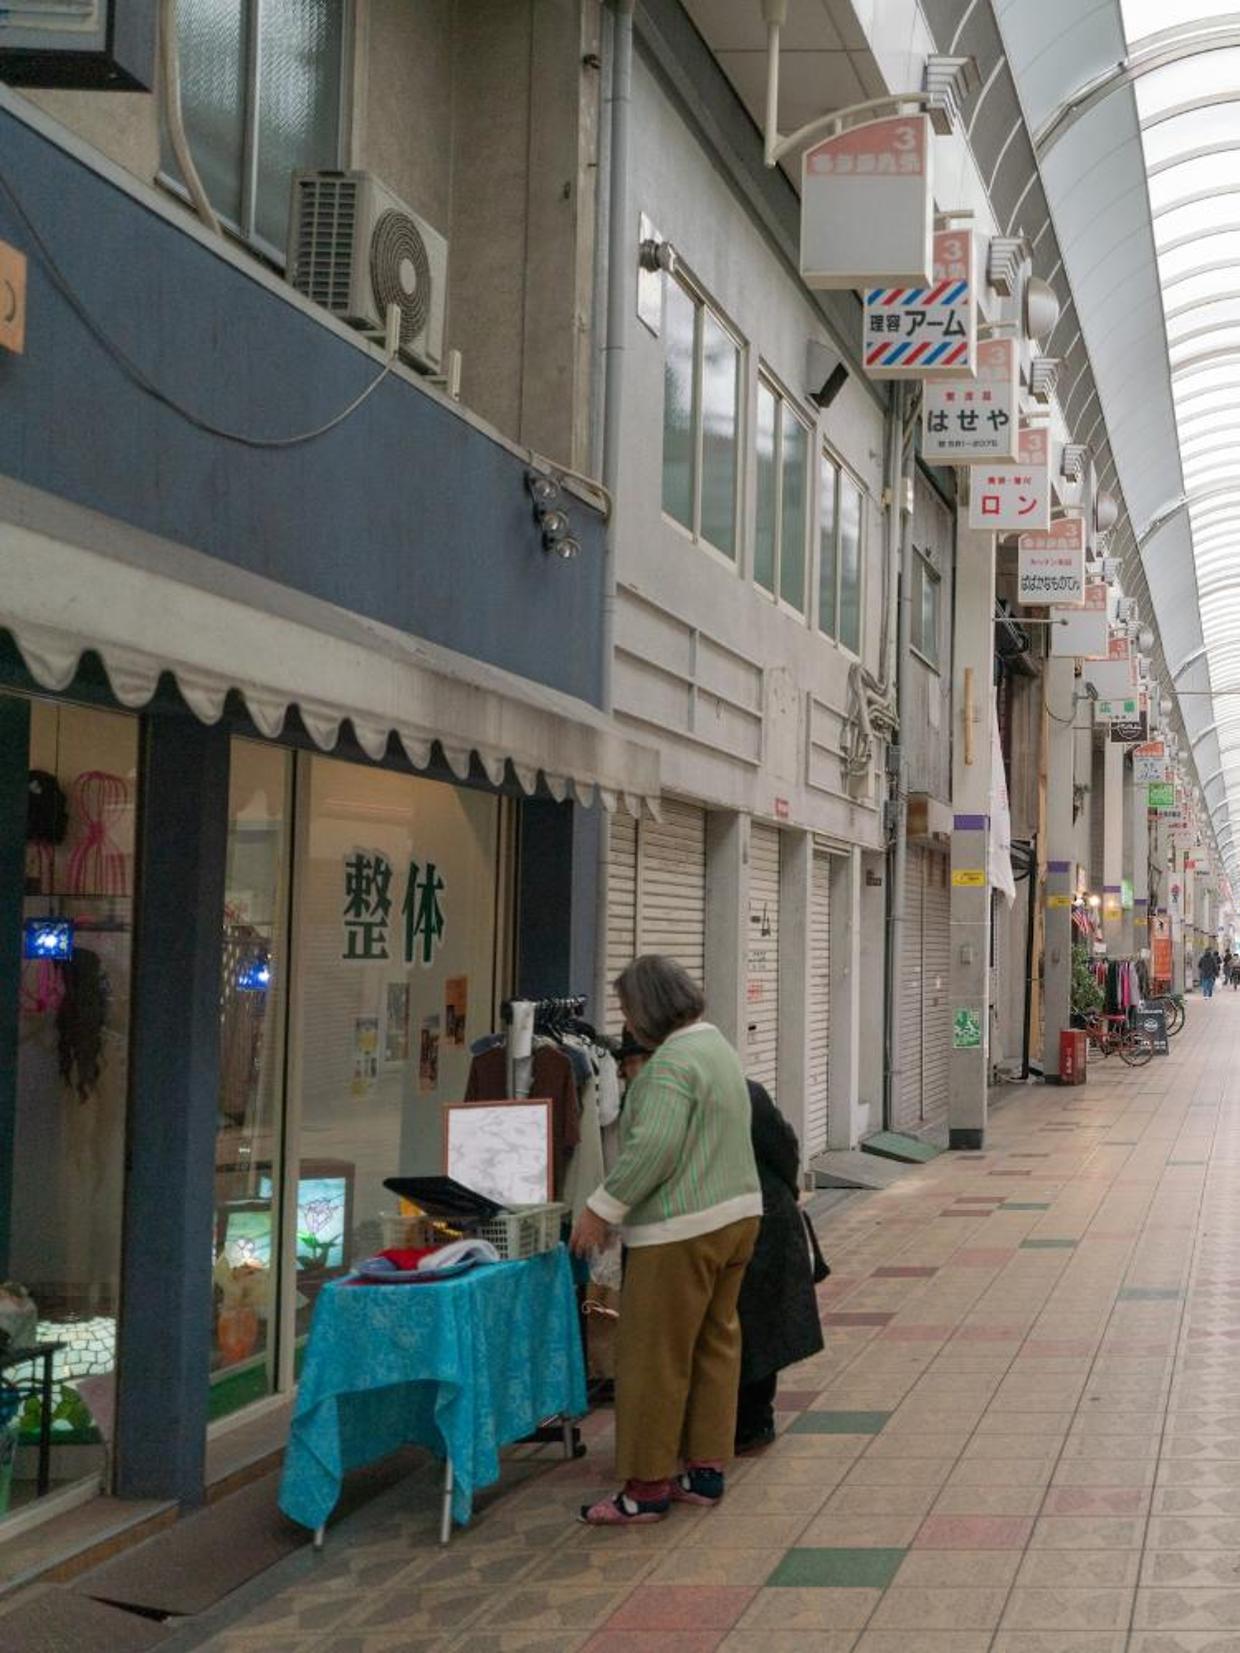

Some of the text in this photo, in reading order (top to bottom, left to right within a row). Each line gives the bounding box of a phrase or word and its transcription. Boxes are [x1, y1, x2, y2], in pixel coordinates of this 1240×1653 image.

[895, 130, 915, 150] 3
[944, 239, 963, 259] 3
[870, 309, 966, 337] 理容 アーム
[990, 346, 1005, 362] 3
[927, 409, 1010, 432] はせや
[1028, 435, 1043, 450] 3
[982, 496, 1037, 515] ロン
[1066, 523, 1077, 536] 3
[342, 853, 444, 962] 整体
